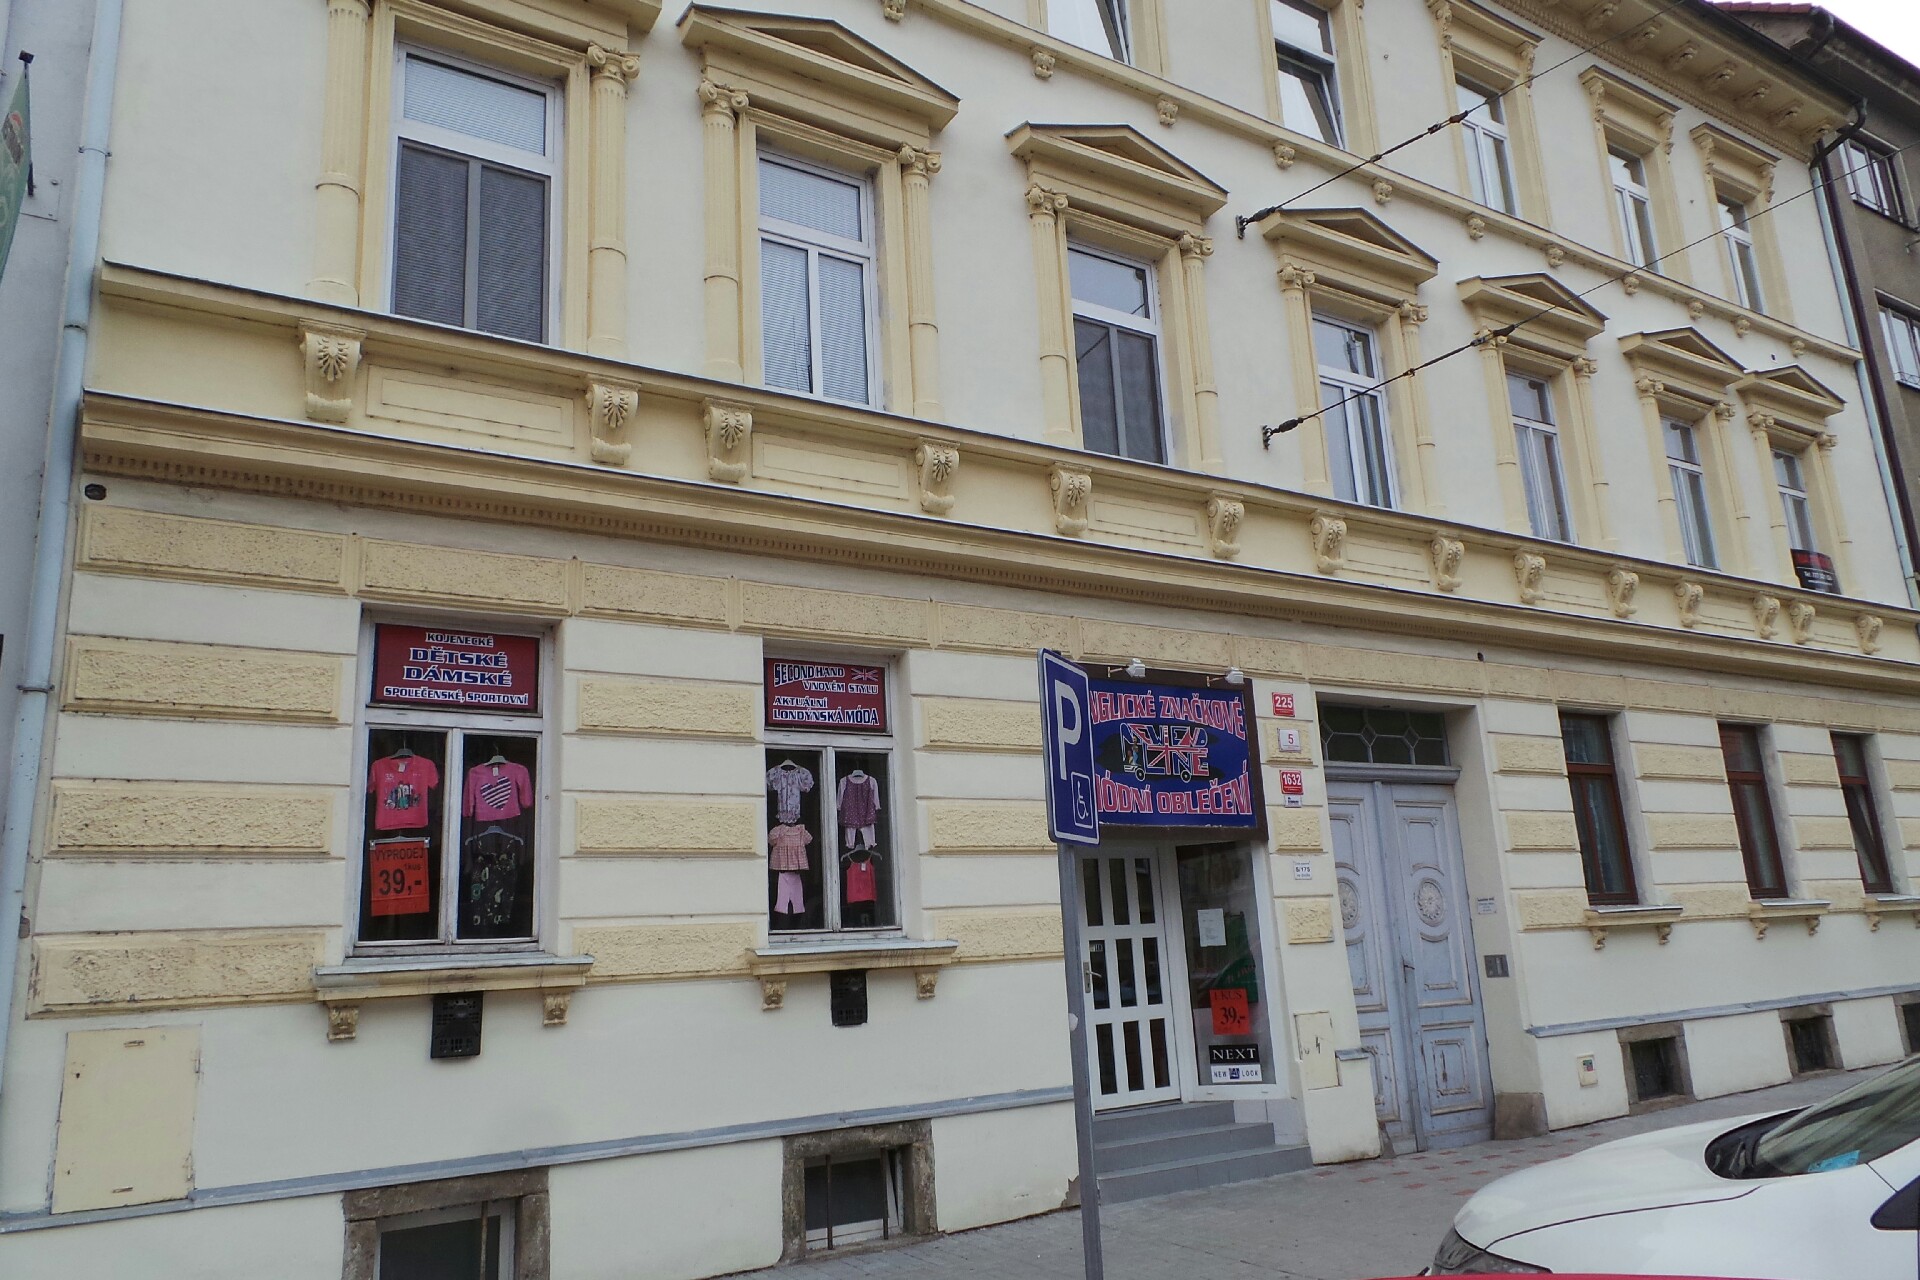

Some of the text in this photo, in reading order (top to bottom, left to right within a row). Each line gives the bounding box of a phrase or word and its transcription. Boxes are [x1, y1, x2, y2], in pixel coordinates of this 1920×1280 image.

[425, 632, 494, 647] KOJENECKÉ
[409, 646, 508, 669] DĚTSKÉ
[403, 665, 512, 687] DÁMSKÉ
[384, 686, 529, 705] SPOLEČENSKÉ, SPORTOVNÍ
[847, 683, 879, 694] STYLU
[773, 695, 828, 708] AKTUÁLNÍ
[1274, 696, 1293, 709] 225
[772, 705, 880, 726] LONDÝNSKÁ MÓDA
[1090, 690, 1246, 741] NGLICKÉ ZNAČKOVÉ
[1054, 679, 1082, 781] P
[1288, 733, 1294, 745] 5
[1157, 759, 1253, 816] OBLEČENÍ
[1282, 773, 1302, 786] 1632
[1212, 1048, 1256, 1060] NEXT
